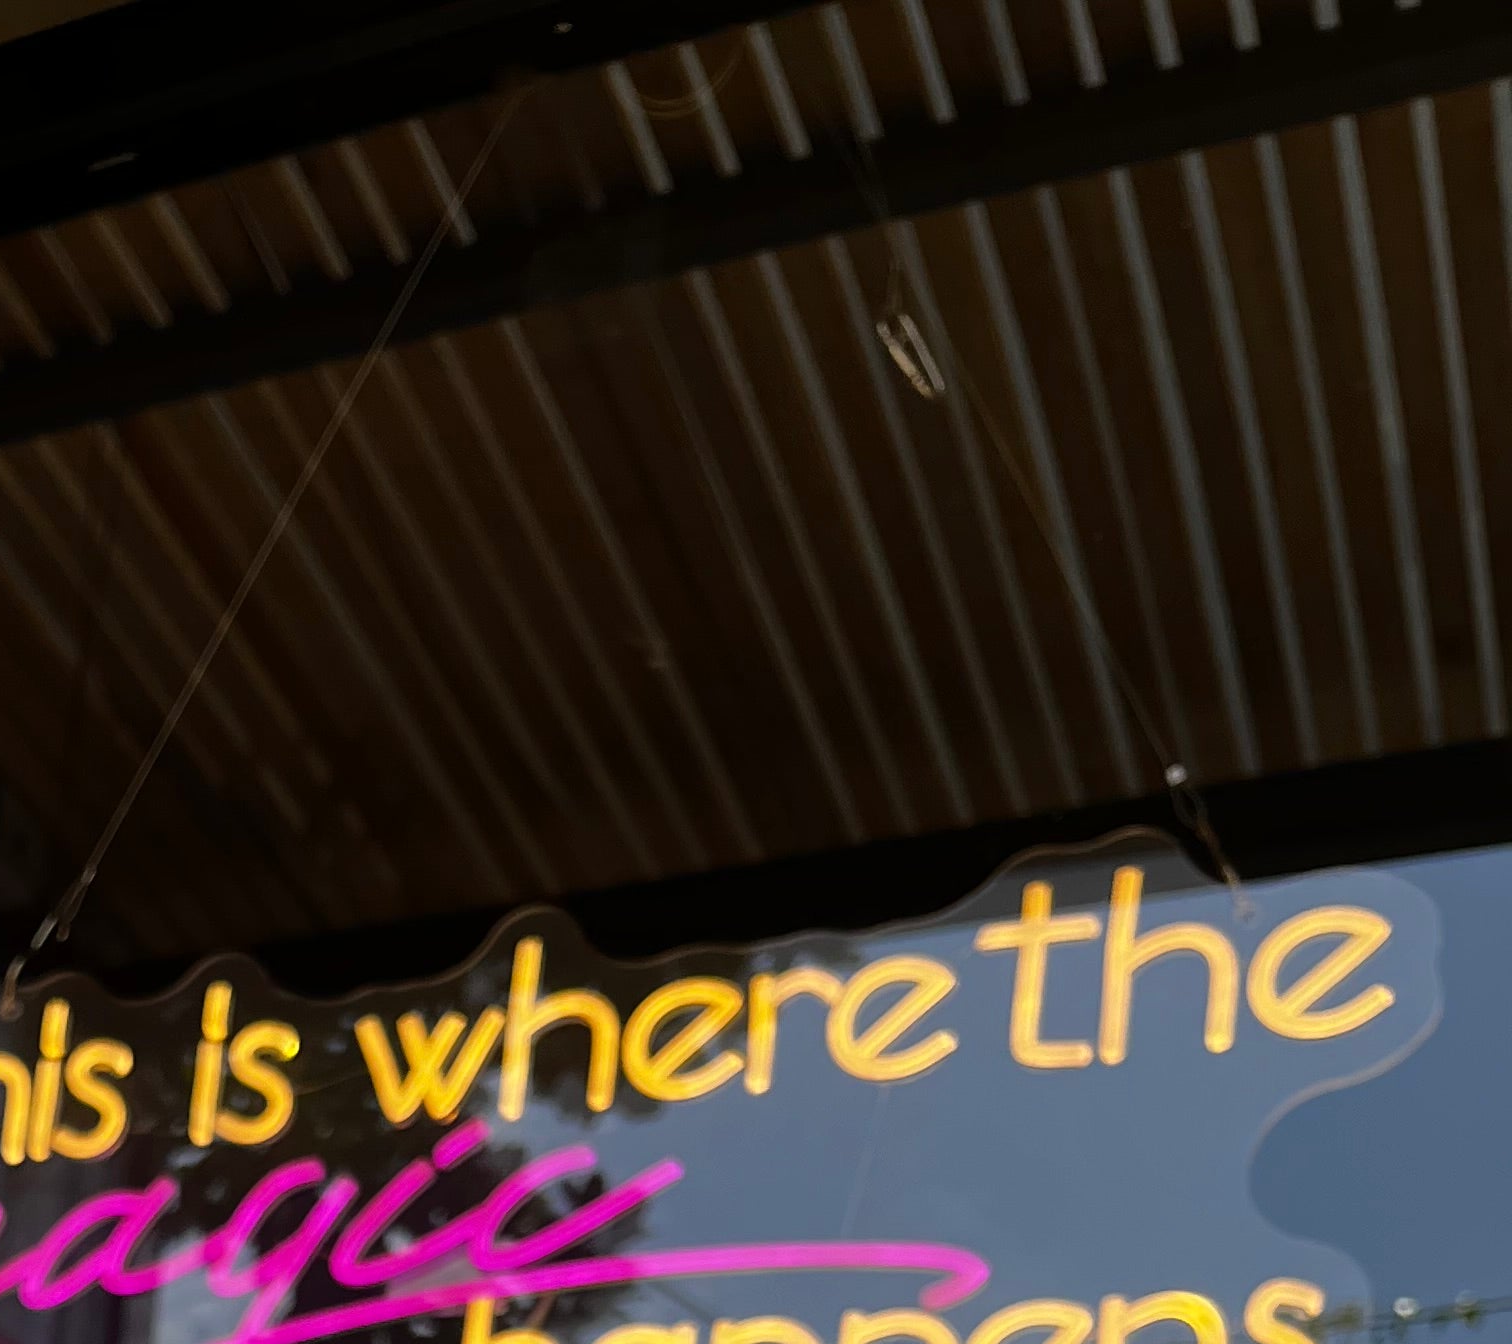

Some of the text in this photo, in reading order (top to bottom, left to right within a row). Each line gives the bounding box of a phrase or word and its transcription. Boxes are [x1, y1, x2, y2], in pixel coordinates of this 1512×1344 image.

[186, 982, 303, 1150] is
[352, 935, 957, 1124] where
[972, 864, 1394, 1069] the
